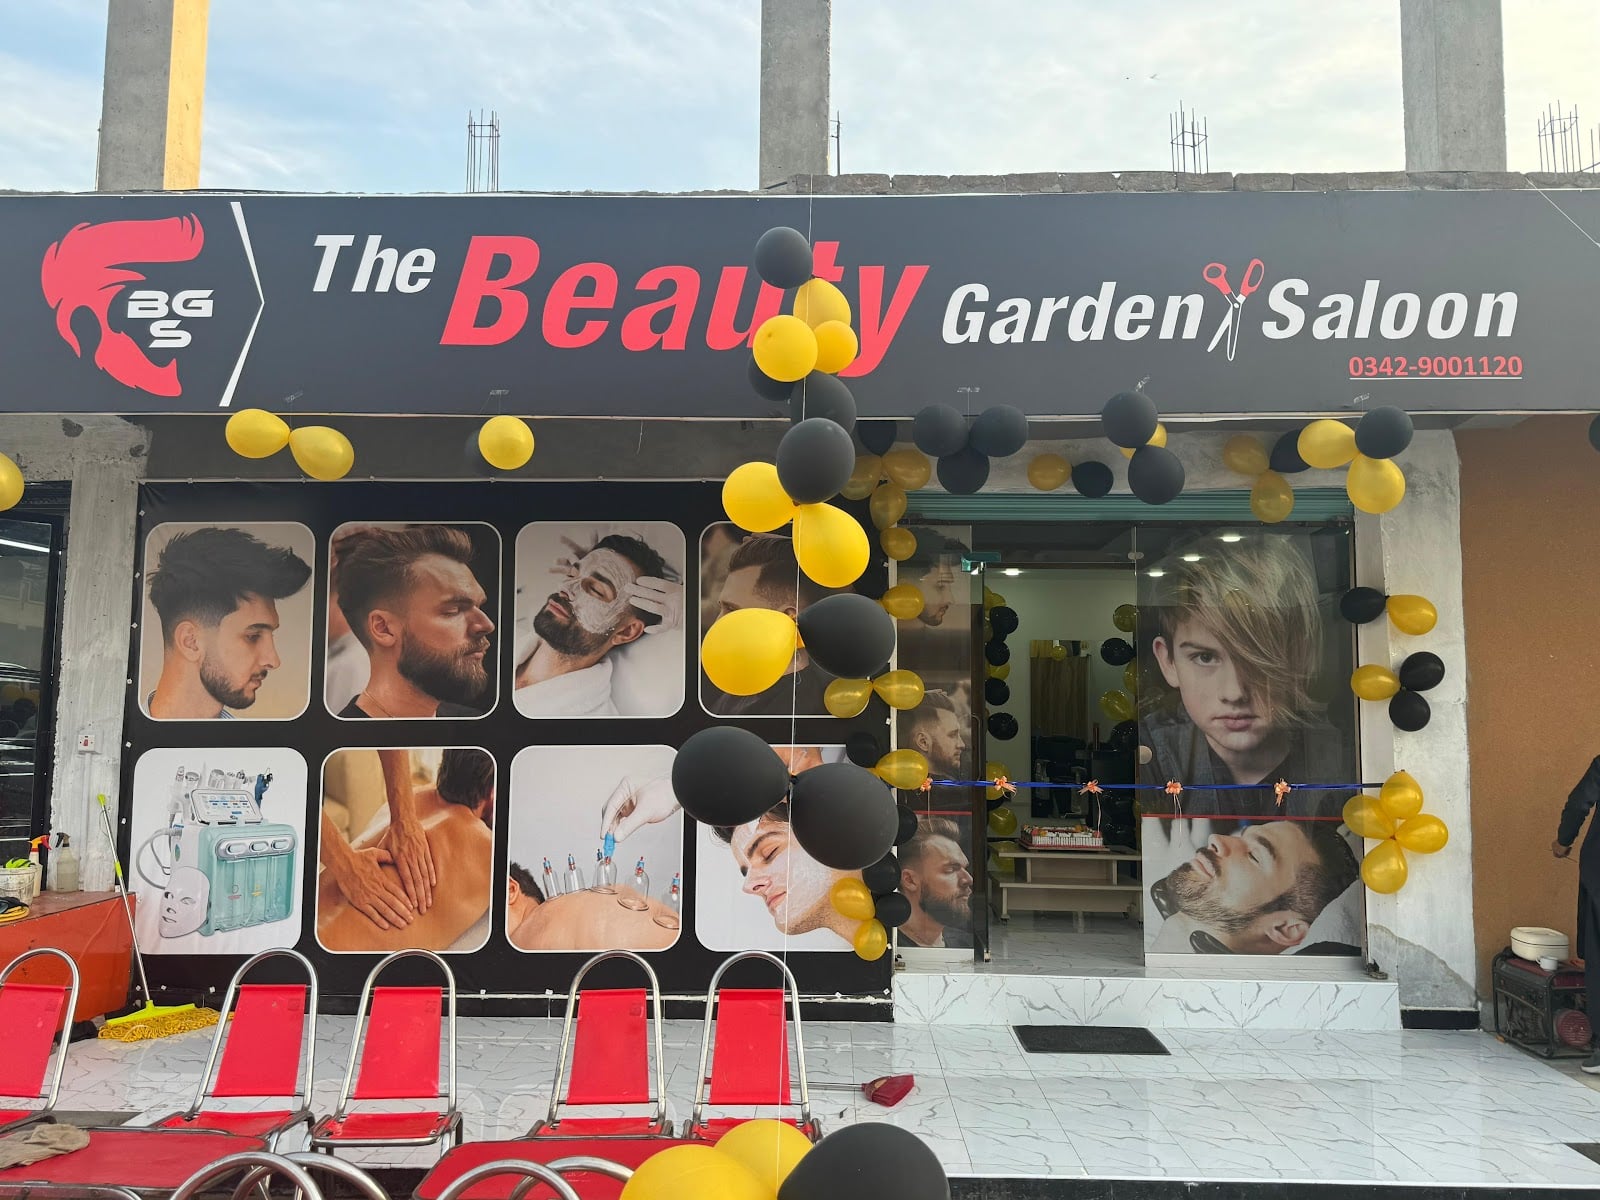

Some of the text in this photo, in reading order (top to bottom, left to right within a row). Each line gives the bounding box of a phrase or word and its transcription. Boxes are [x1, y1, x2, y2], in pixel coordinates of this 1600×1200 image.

[312, 234, 436, 294] The
[941, 281, 1205, 344] Garden
[1262, 279, 1519, 340] Saloon
[127, 289, 214, 319] BG
[148, 319, 192, 348] S
[1349, 356, 1523, 377] 0342-9001120
